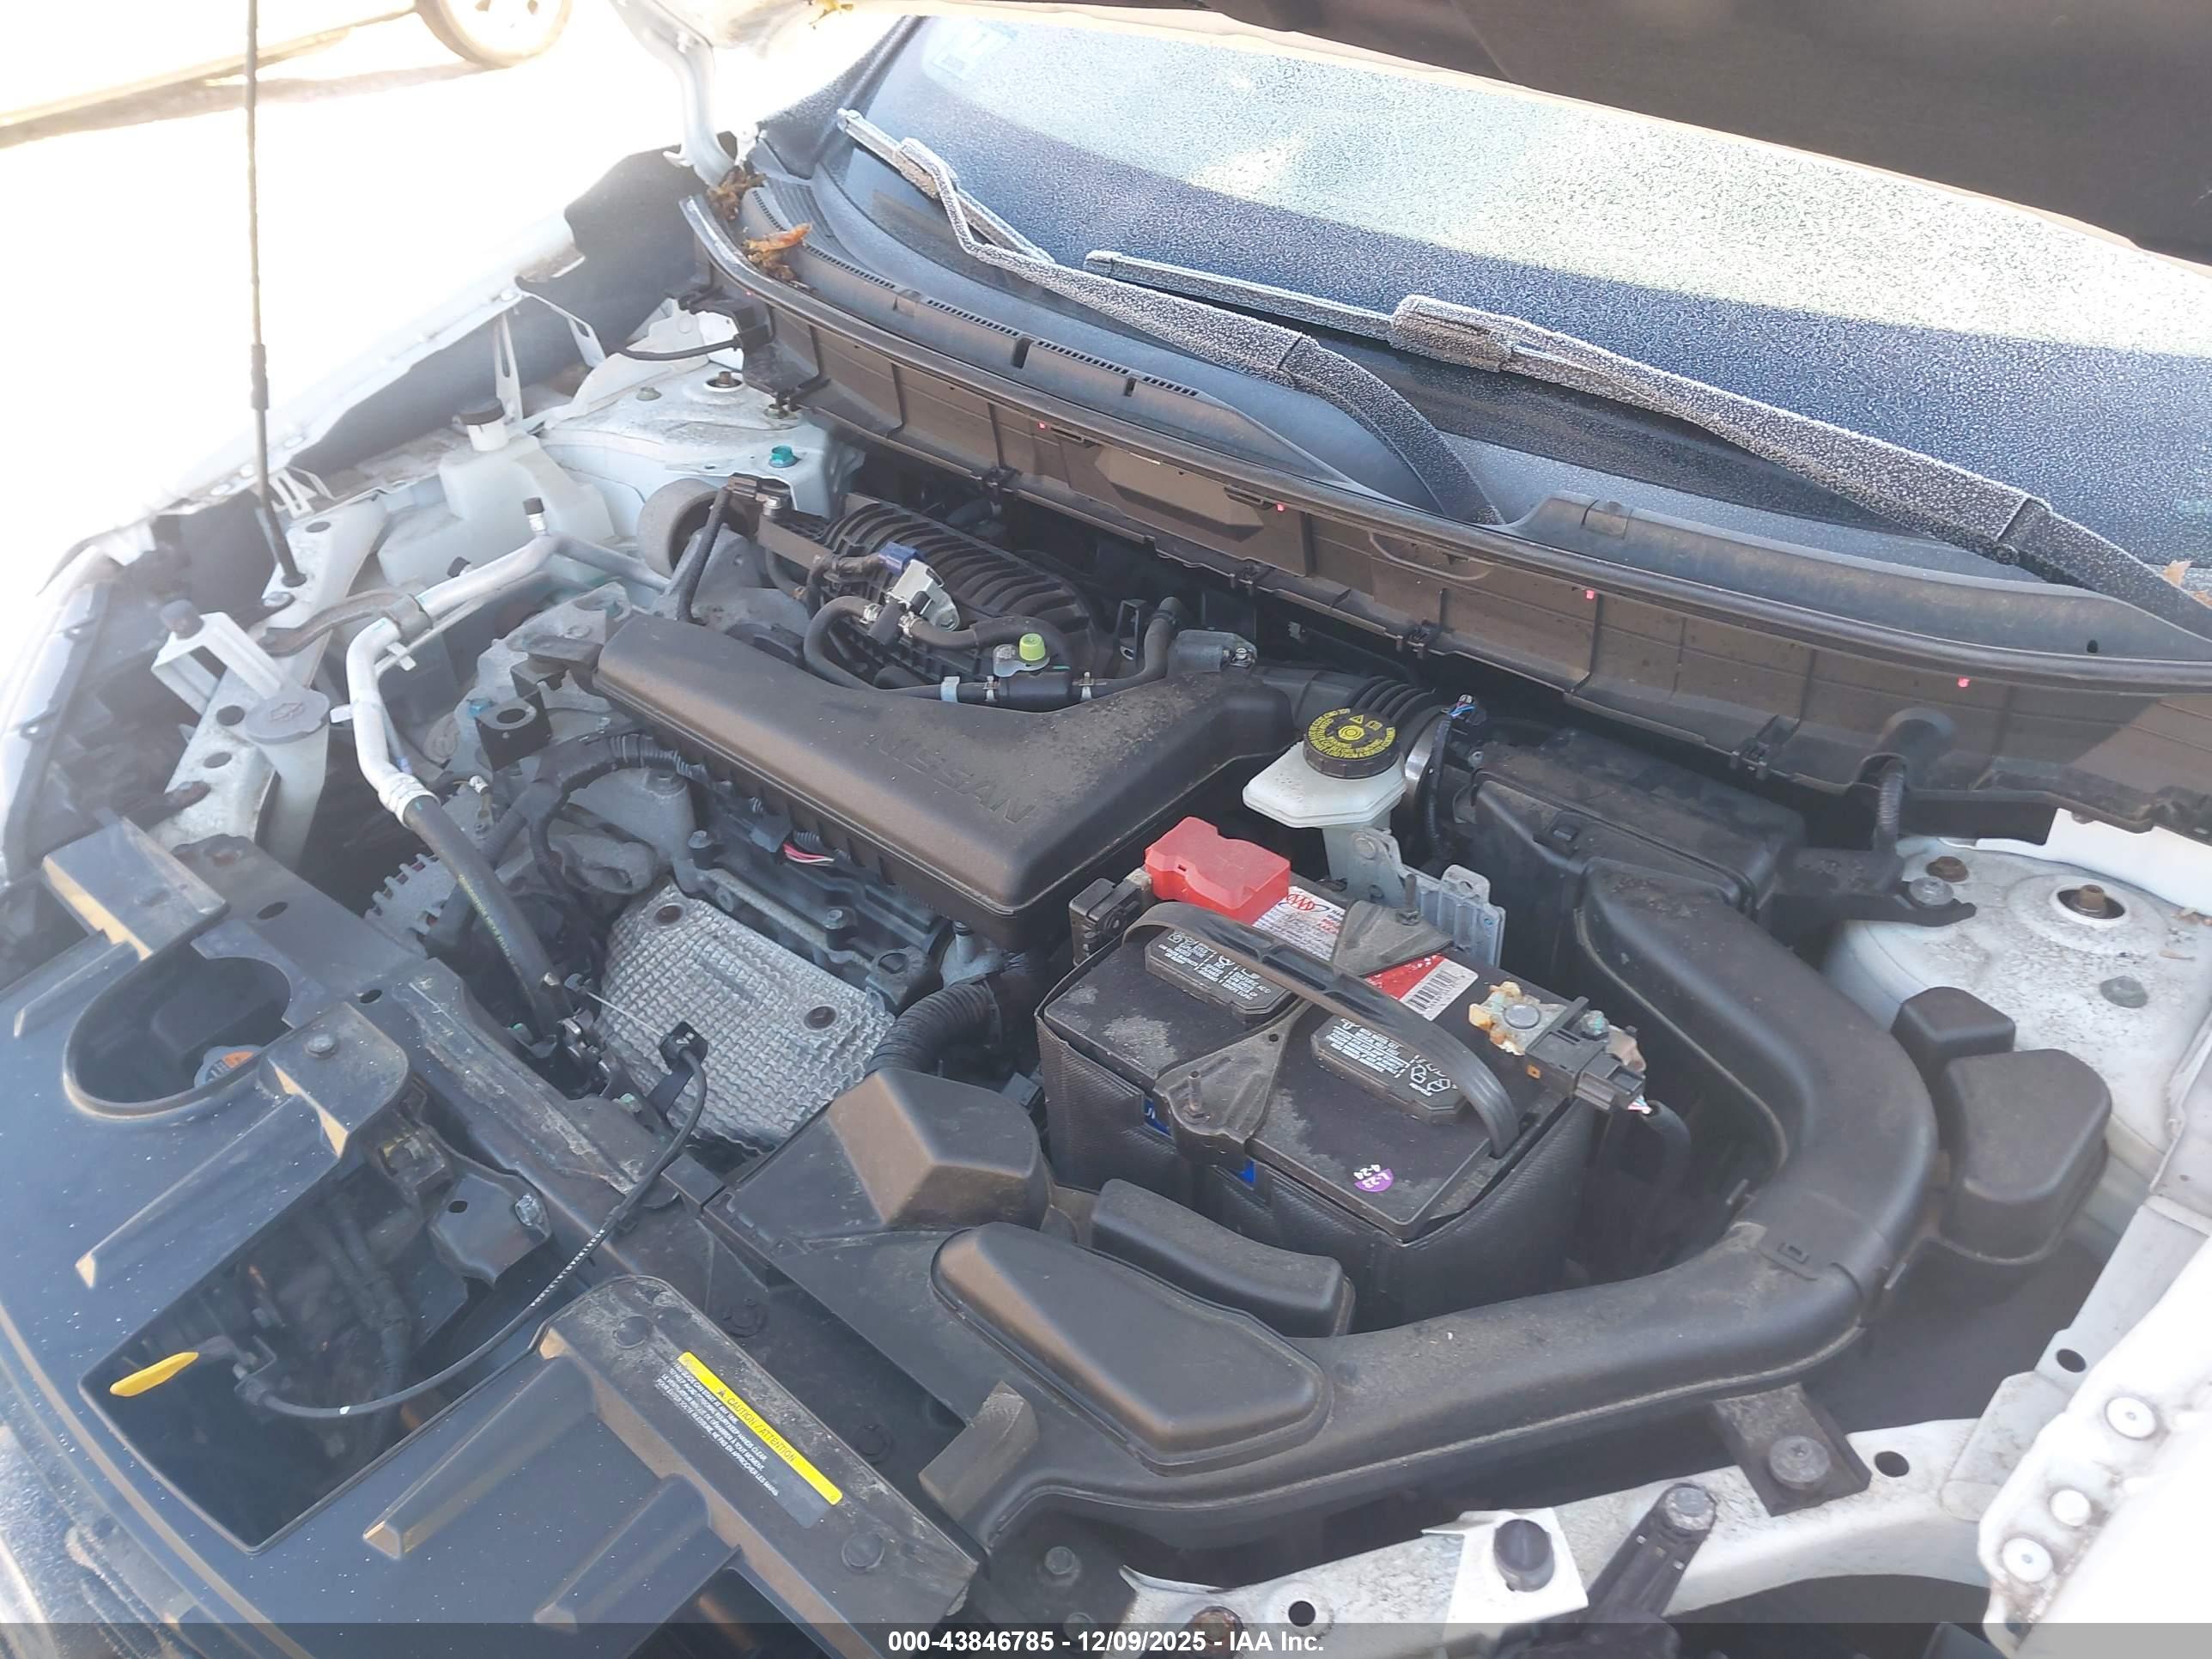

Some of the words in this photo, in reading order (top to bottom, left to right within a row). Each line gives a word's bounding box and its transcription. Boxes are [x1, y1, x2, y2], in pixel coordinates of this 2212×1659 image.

[865, 728, 1037, 823] NISSAN
[1287, 894, 1315, 911] AAA
[726, 1397, 756, 1424] CAUTION
[758, 1428, 796, 1461] ATTENTION
